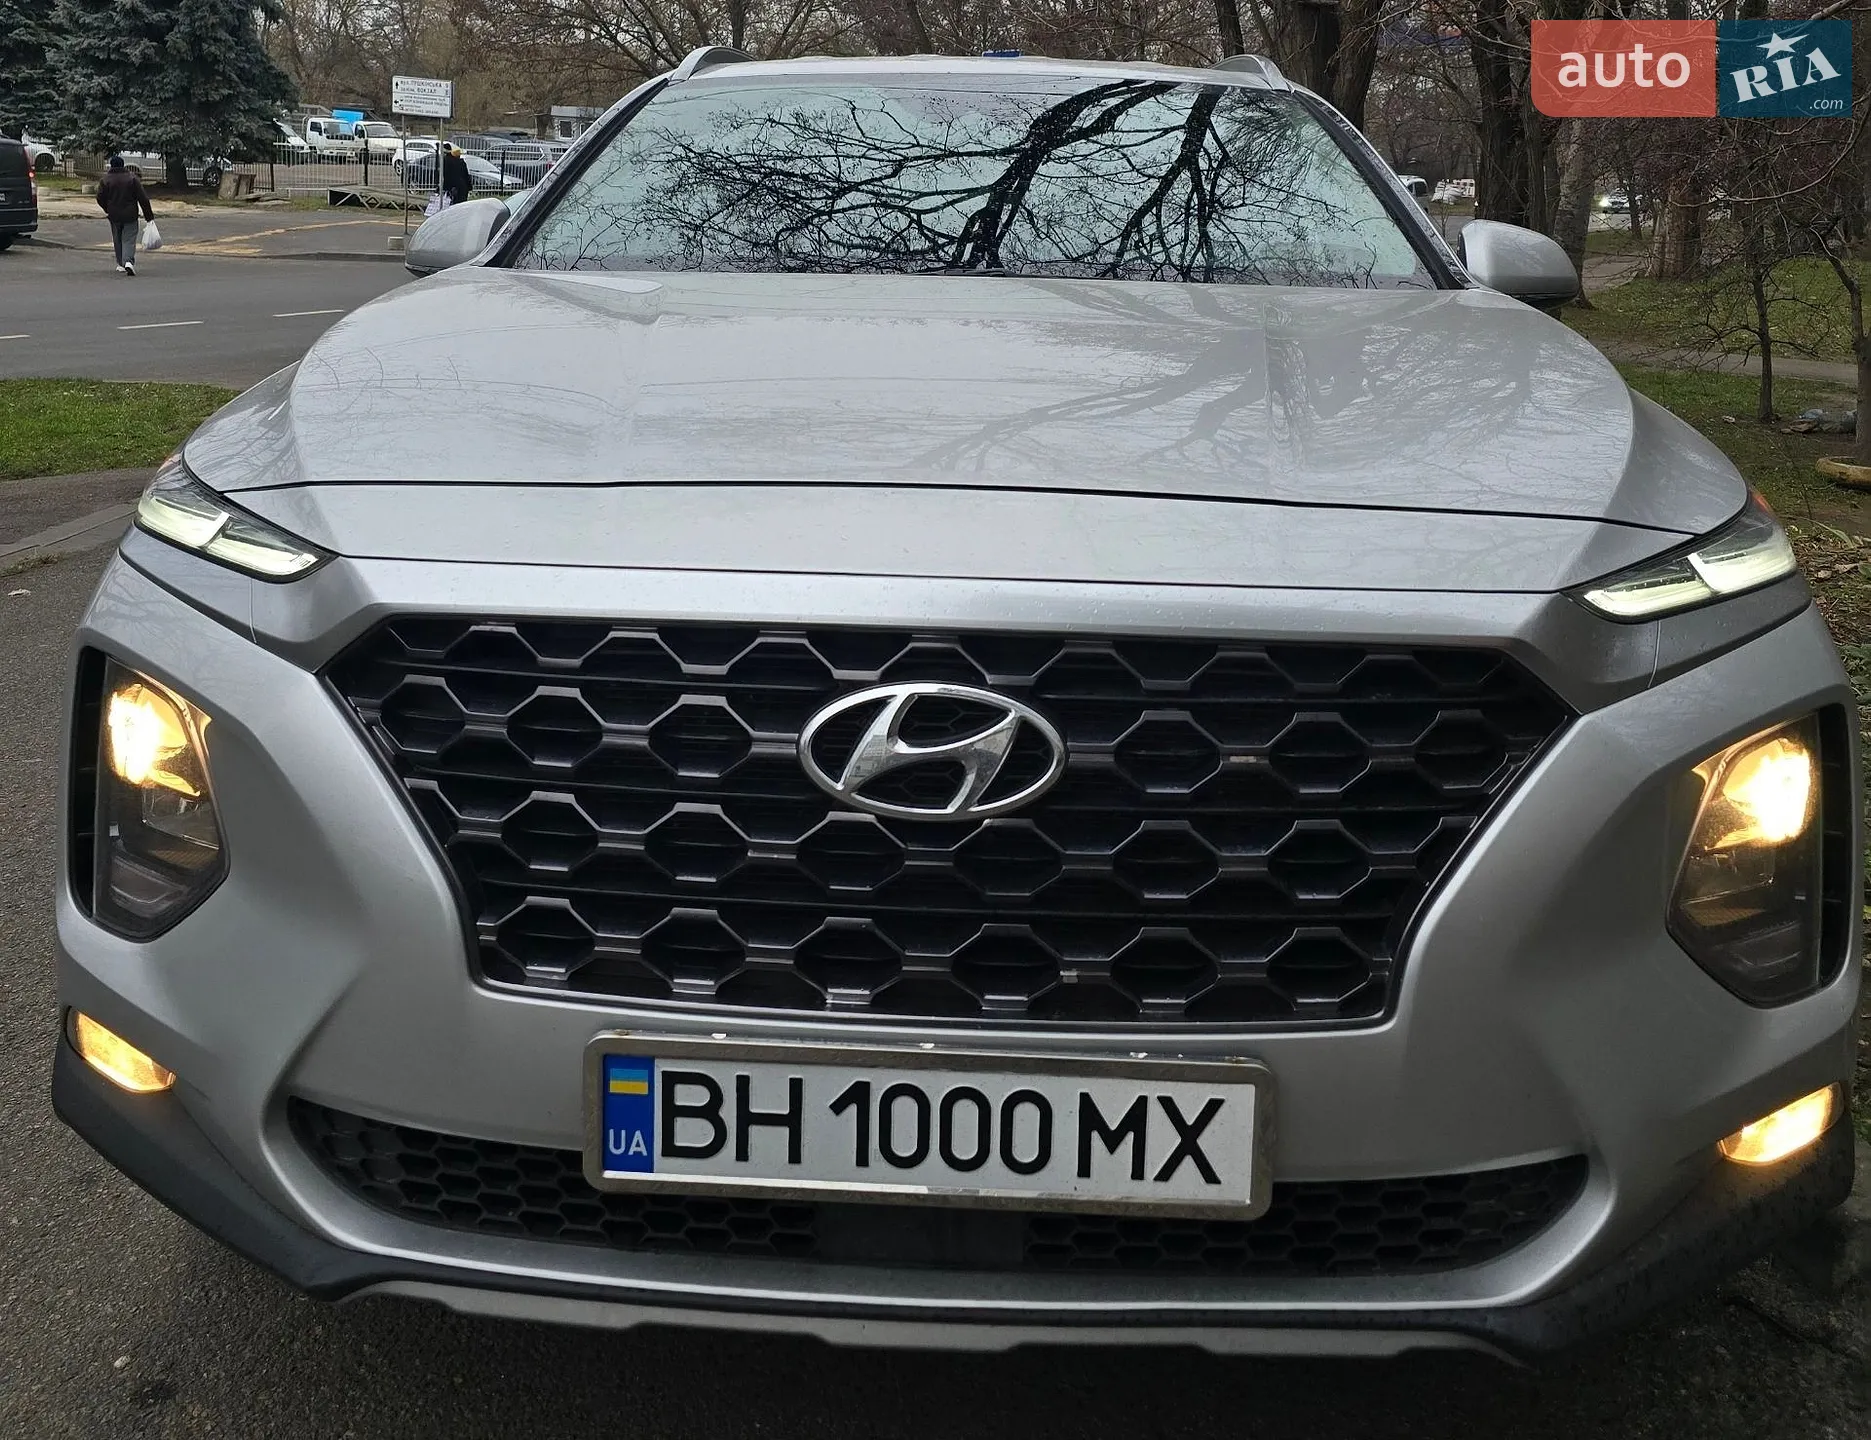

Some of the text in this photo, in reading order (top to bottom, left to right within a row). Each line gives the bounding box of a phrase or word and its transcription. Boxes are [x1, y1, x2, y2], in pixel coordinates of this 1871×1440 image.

[609, 1128, 648, 1156] UA
[661, 1070, 1225, 1184] BH 1000 MX
